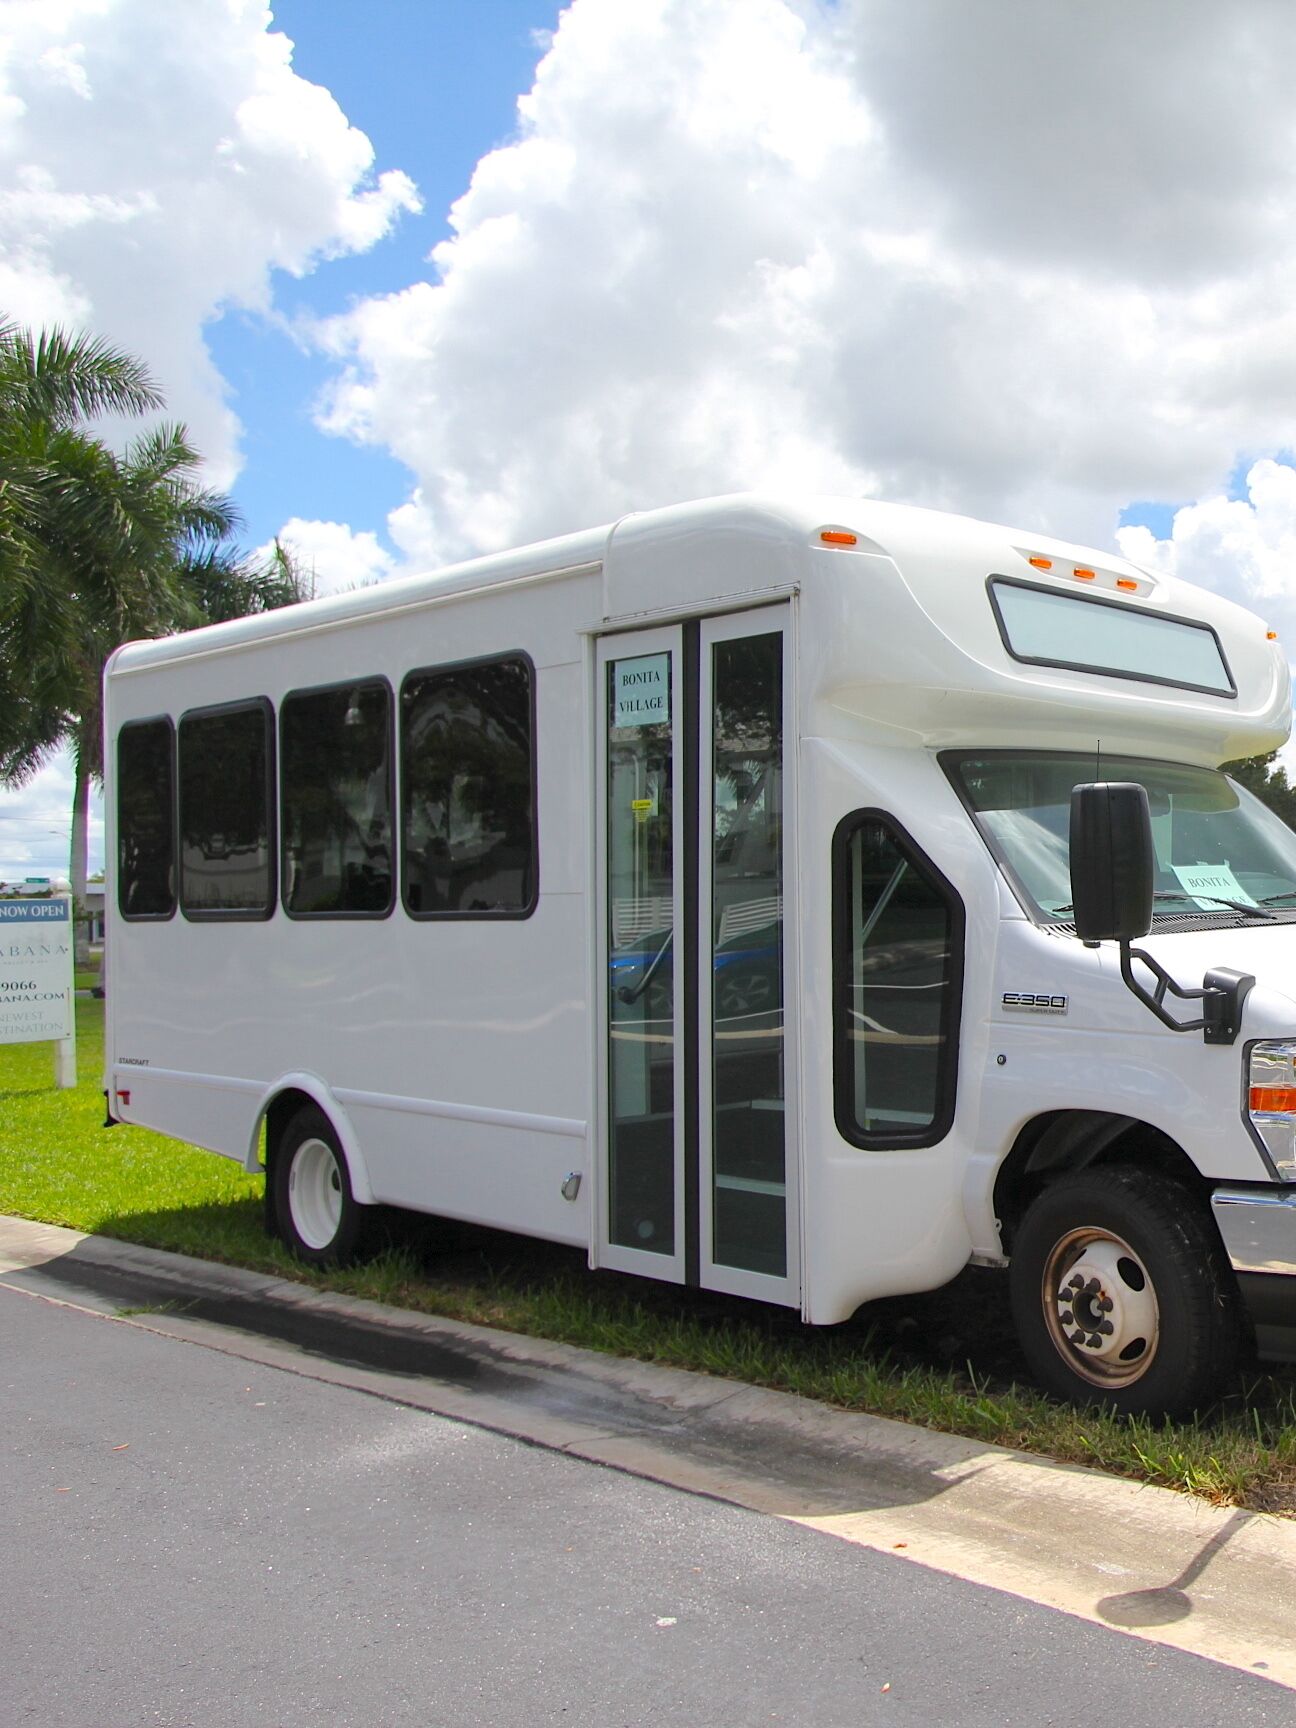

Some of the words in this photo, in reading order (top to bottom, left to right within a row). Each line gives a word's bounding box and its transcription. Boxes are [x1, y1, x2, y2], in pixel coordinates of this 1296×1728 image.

[622, 670, 660, 687] BONITA
[619, 696, 663, 712] VILLAGE
[1187, 876, 1231, 888] BONITA
[0, 905, 28, 917] NOW
[31, 904, 64, 917] OPEN
[1, 981, 37, 992] 9066
[0, 992, 65, 1002] ANA.COM
